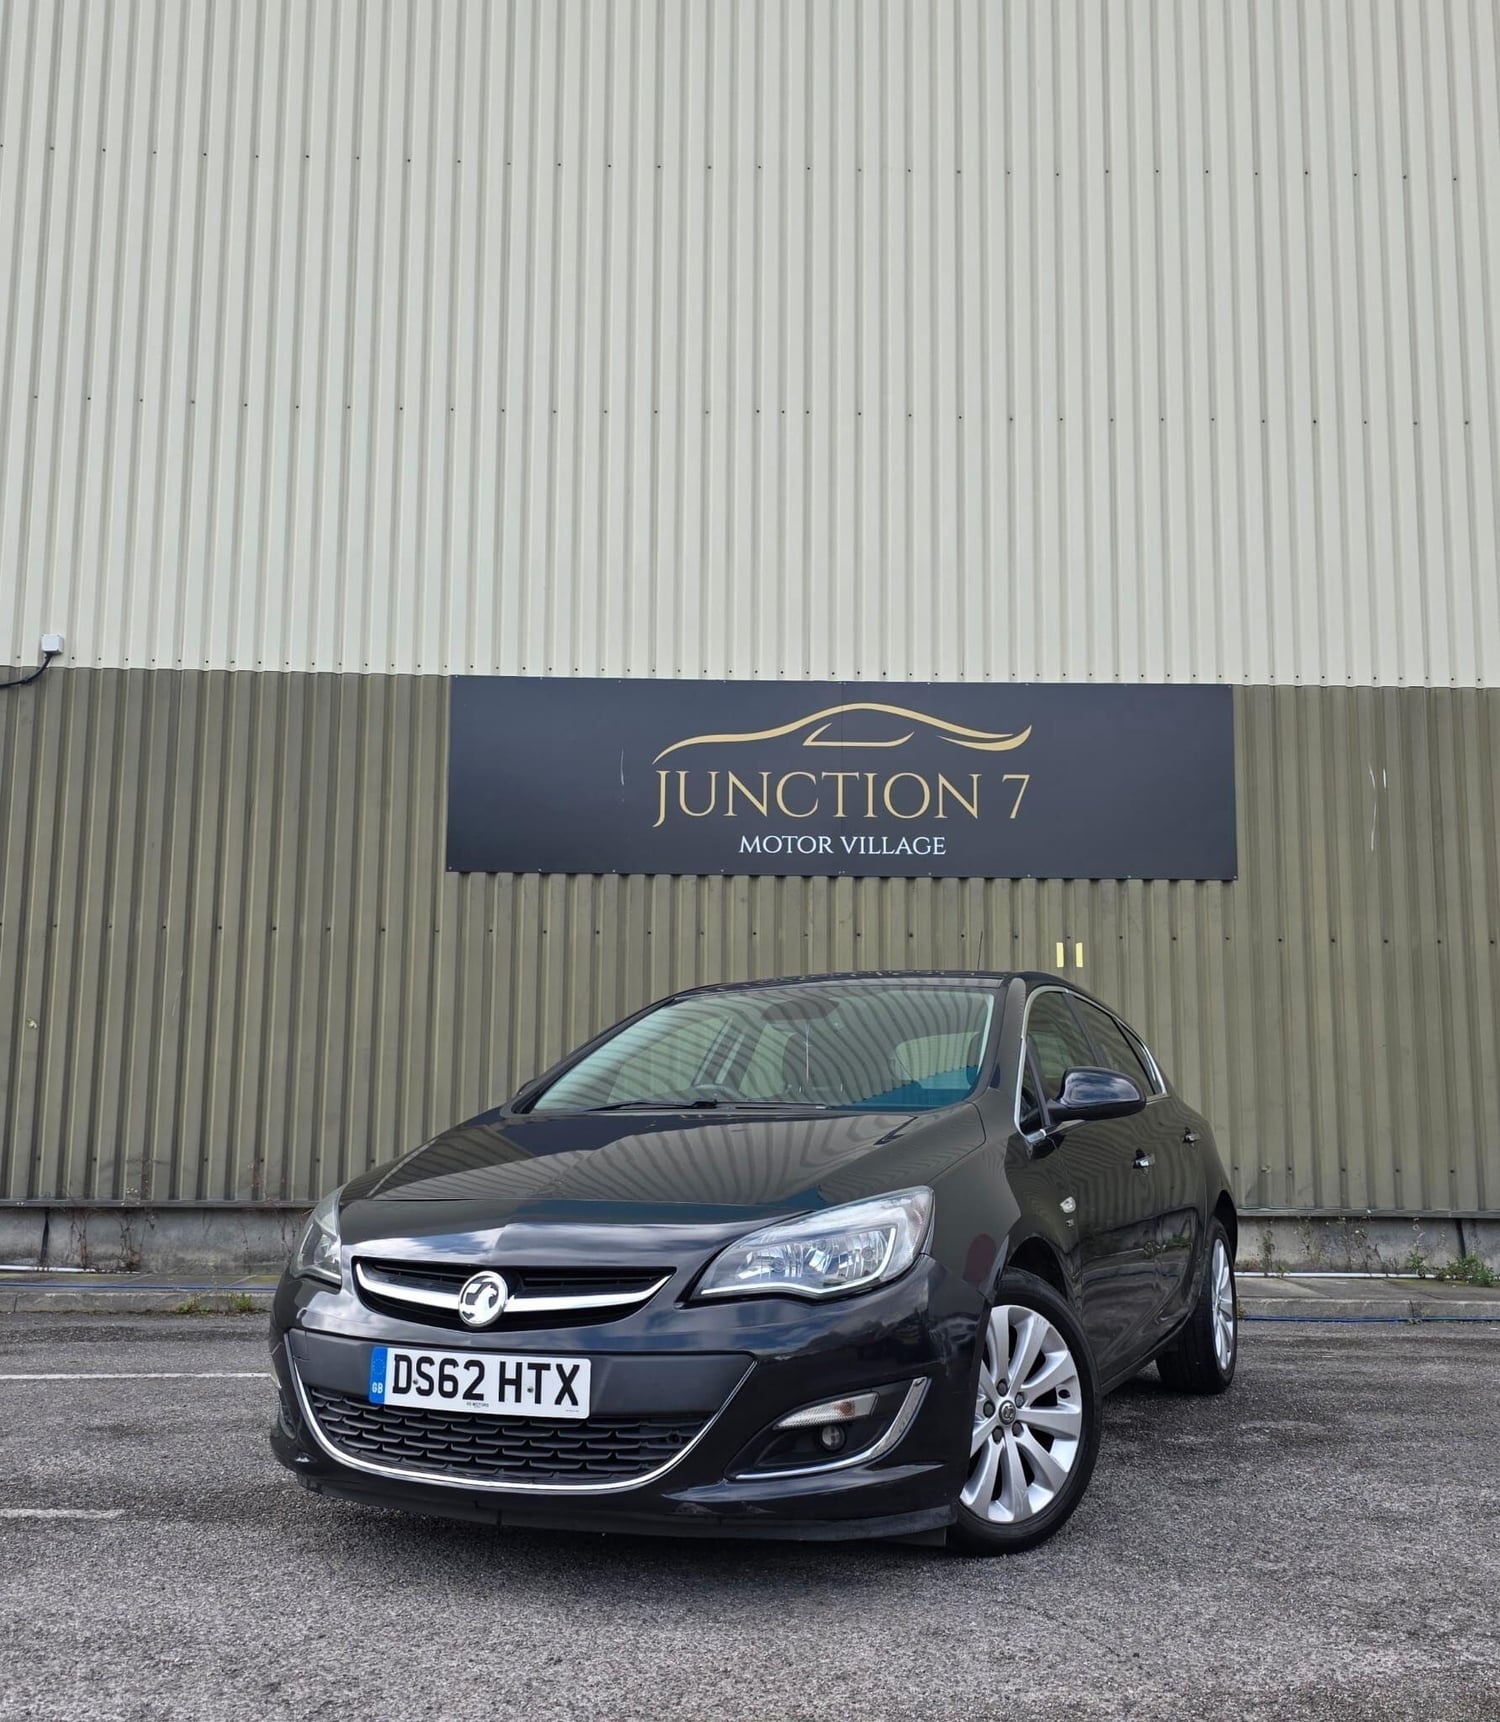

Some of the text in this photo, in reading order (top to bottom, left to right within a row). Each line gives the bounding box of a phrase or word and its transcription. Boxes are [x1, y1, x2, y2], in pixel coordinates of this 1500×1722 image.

[652, 770, 1031, 828] JUNCTION 7
[739, 835, 946, 856] MOTOR VILLAGE
[371, 1382, 384, 1394] GB
[392, 1353, 580, 1406] DS62 HTX
